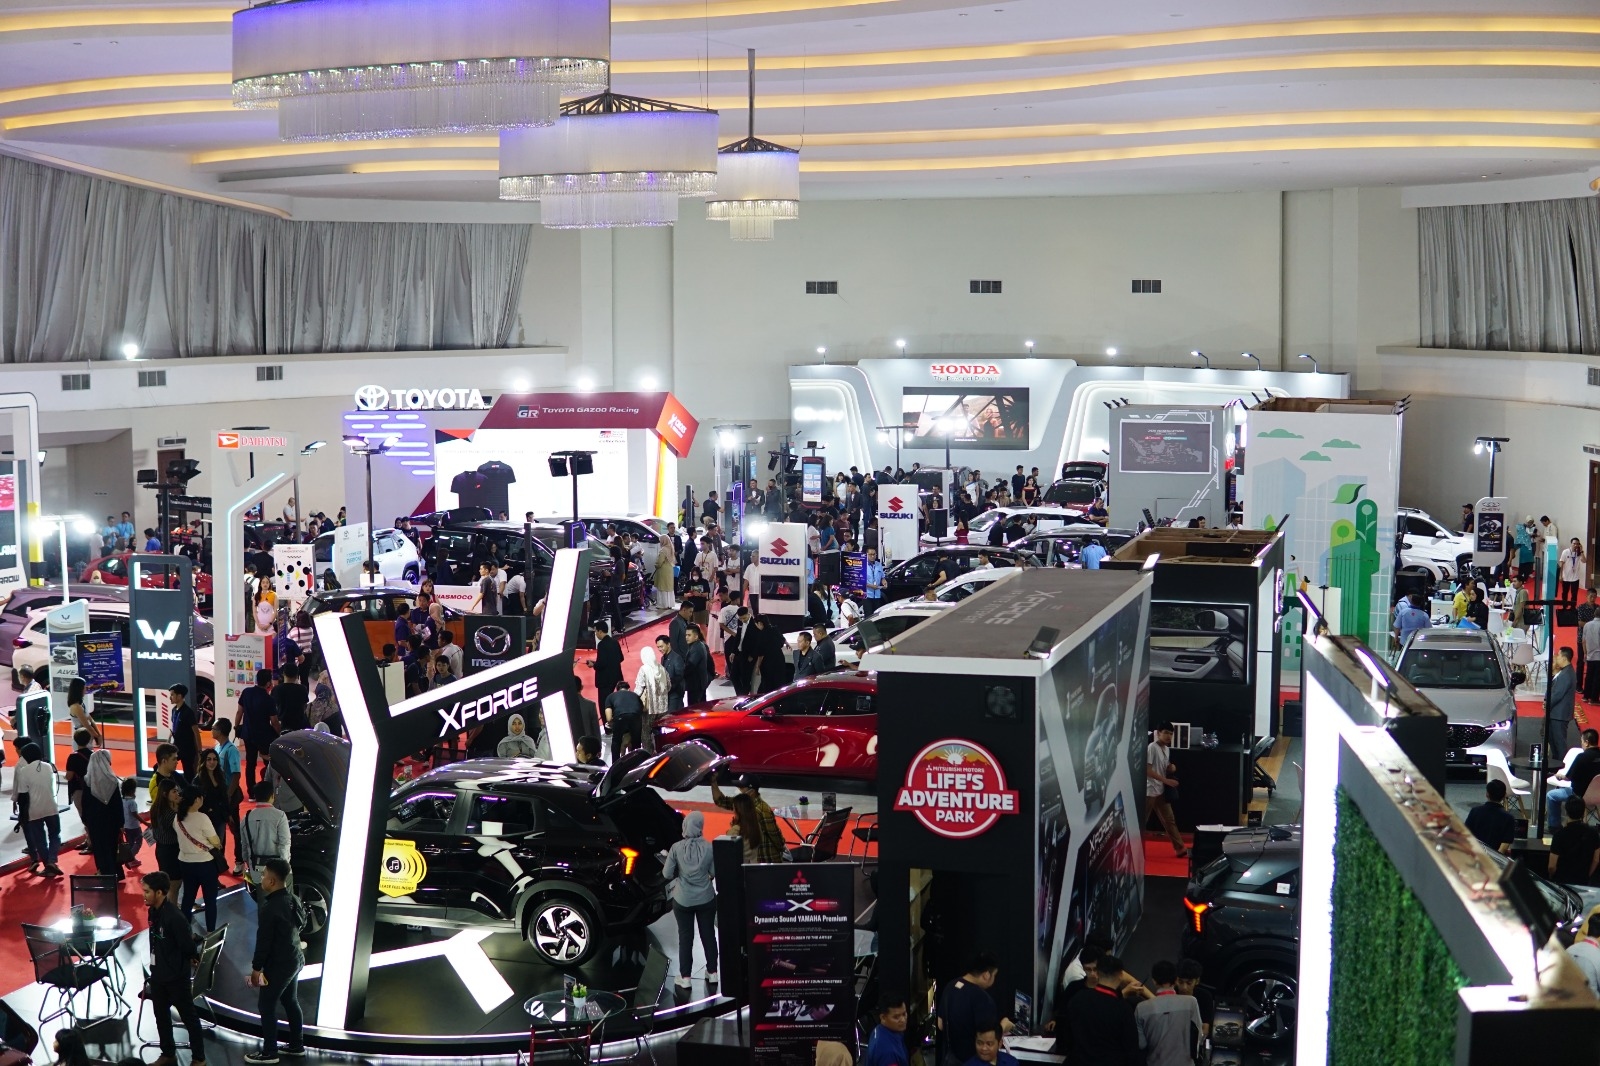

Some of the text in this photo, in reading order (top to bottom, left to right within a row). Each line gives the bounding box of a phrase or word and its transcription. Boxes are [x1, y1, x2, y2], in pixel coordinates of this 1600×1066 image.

[931, 365, 1000, 375] HONDA
[391, 387, 485, 409] TOYOTA
[518, 408, 539, 418] GR
[609, 406, 639, 414] Racing
[241, 437, 287, 447] DAIHATSU
[760, 557, 800, 566] SUZUKI
[137, 652, 182, 661] WULING
[438, 676, 539, 738] XFORCE
[926, 772, 984, 791] LIFE'S
[898, 790, 1014, 811] ADVENTURE
[935, 810, 975, 823] PARK
[754, 915, 779, 925] Dynamic
[798, 915, 822, 923] YAMAHA
[822, 914, 848, 922] Premium
